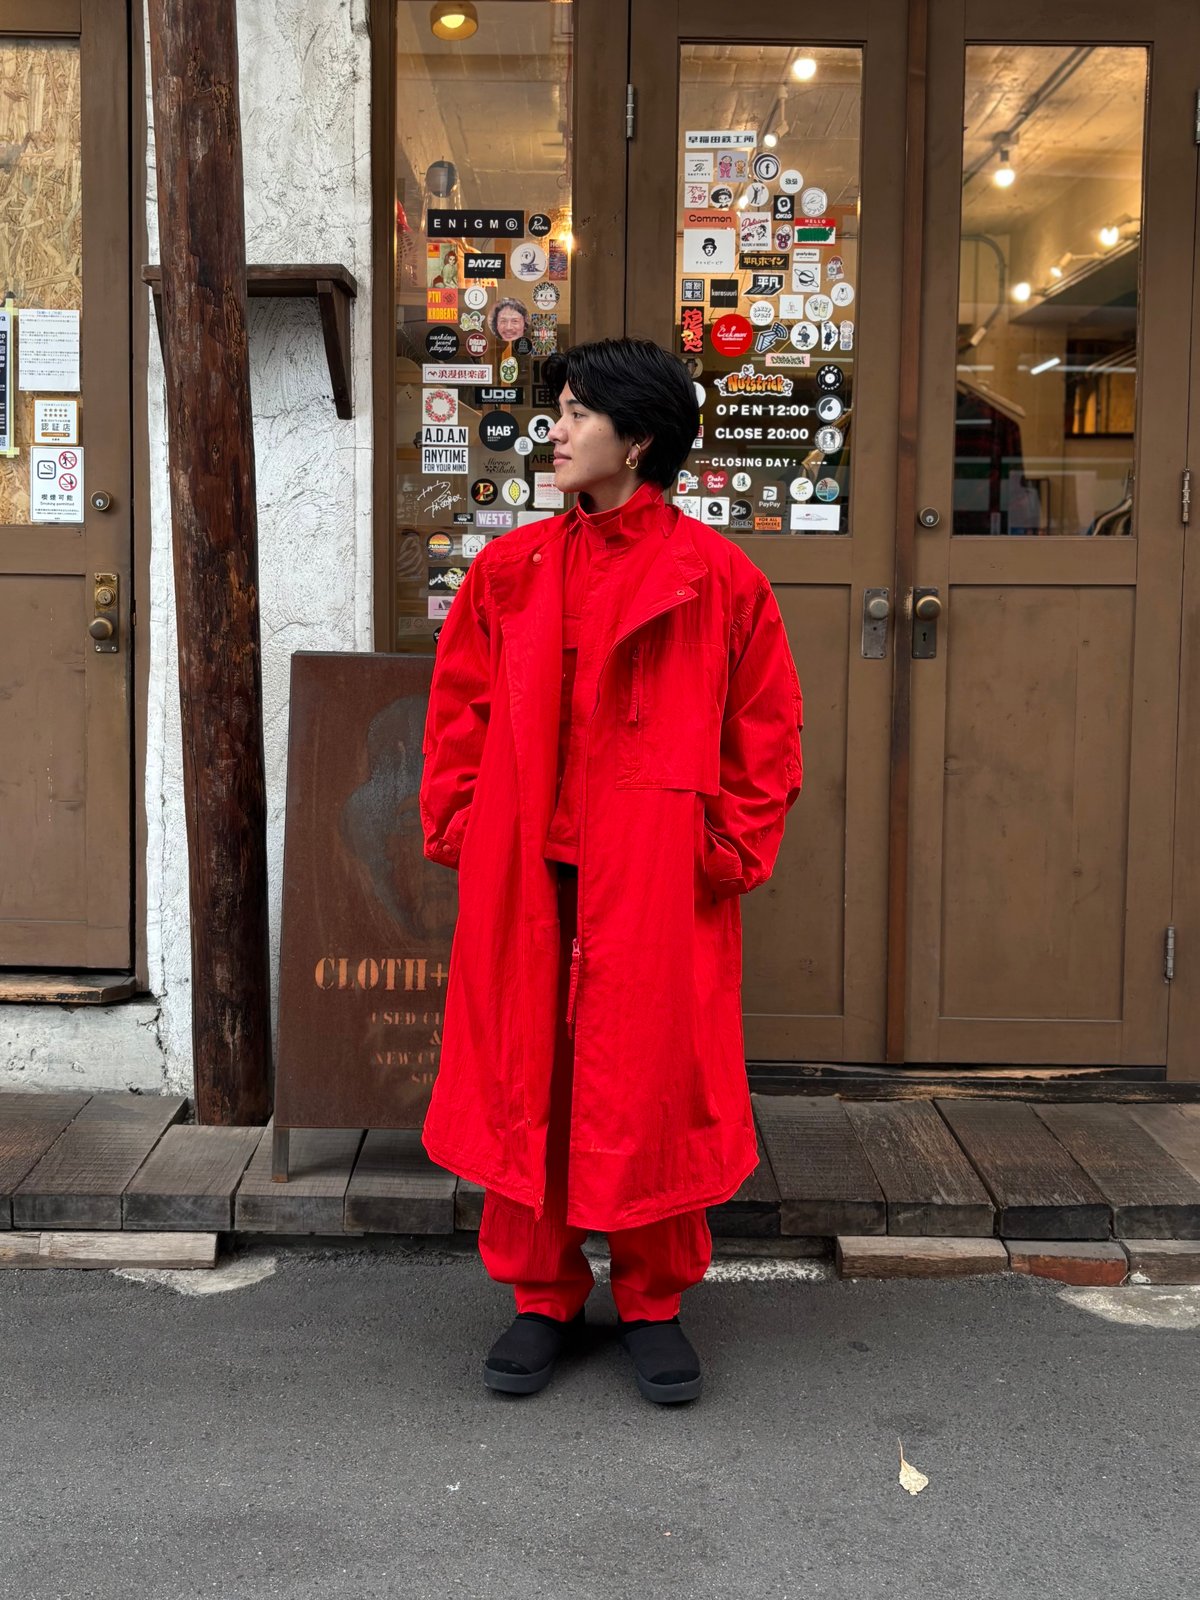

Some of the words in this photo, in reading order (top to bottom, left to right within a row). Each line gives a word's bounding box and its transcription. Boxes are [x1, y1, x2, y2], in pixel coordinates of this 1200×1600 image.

[688, 214, 732, 223] Common
[467, 258, 502, 268] DAYZE
[727, 374, 784, 392] Nutstrick
[481, 389, 517, 399] UDG
[716, 404, 762, 416] OPEN
[768, 404, 809, 417] 12:00
[424, 428, 467, 443] A.D.A.N
[715, 427, 763, 440] CLOSE
[767, 428, 809, 440] 20:00
[424, 449, 467, 463] ANYTIME
[711, 457, 763, 467] CLOSING
[424, 463, 435, 472] FOR
[436, 463, 452, 472] YOUR
[452, 464, 467, 472] MIND
[478, 512, 512, 525] WEST'S
[374, 1051, 412, 1065] NEW
